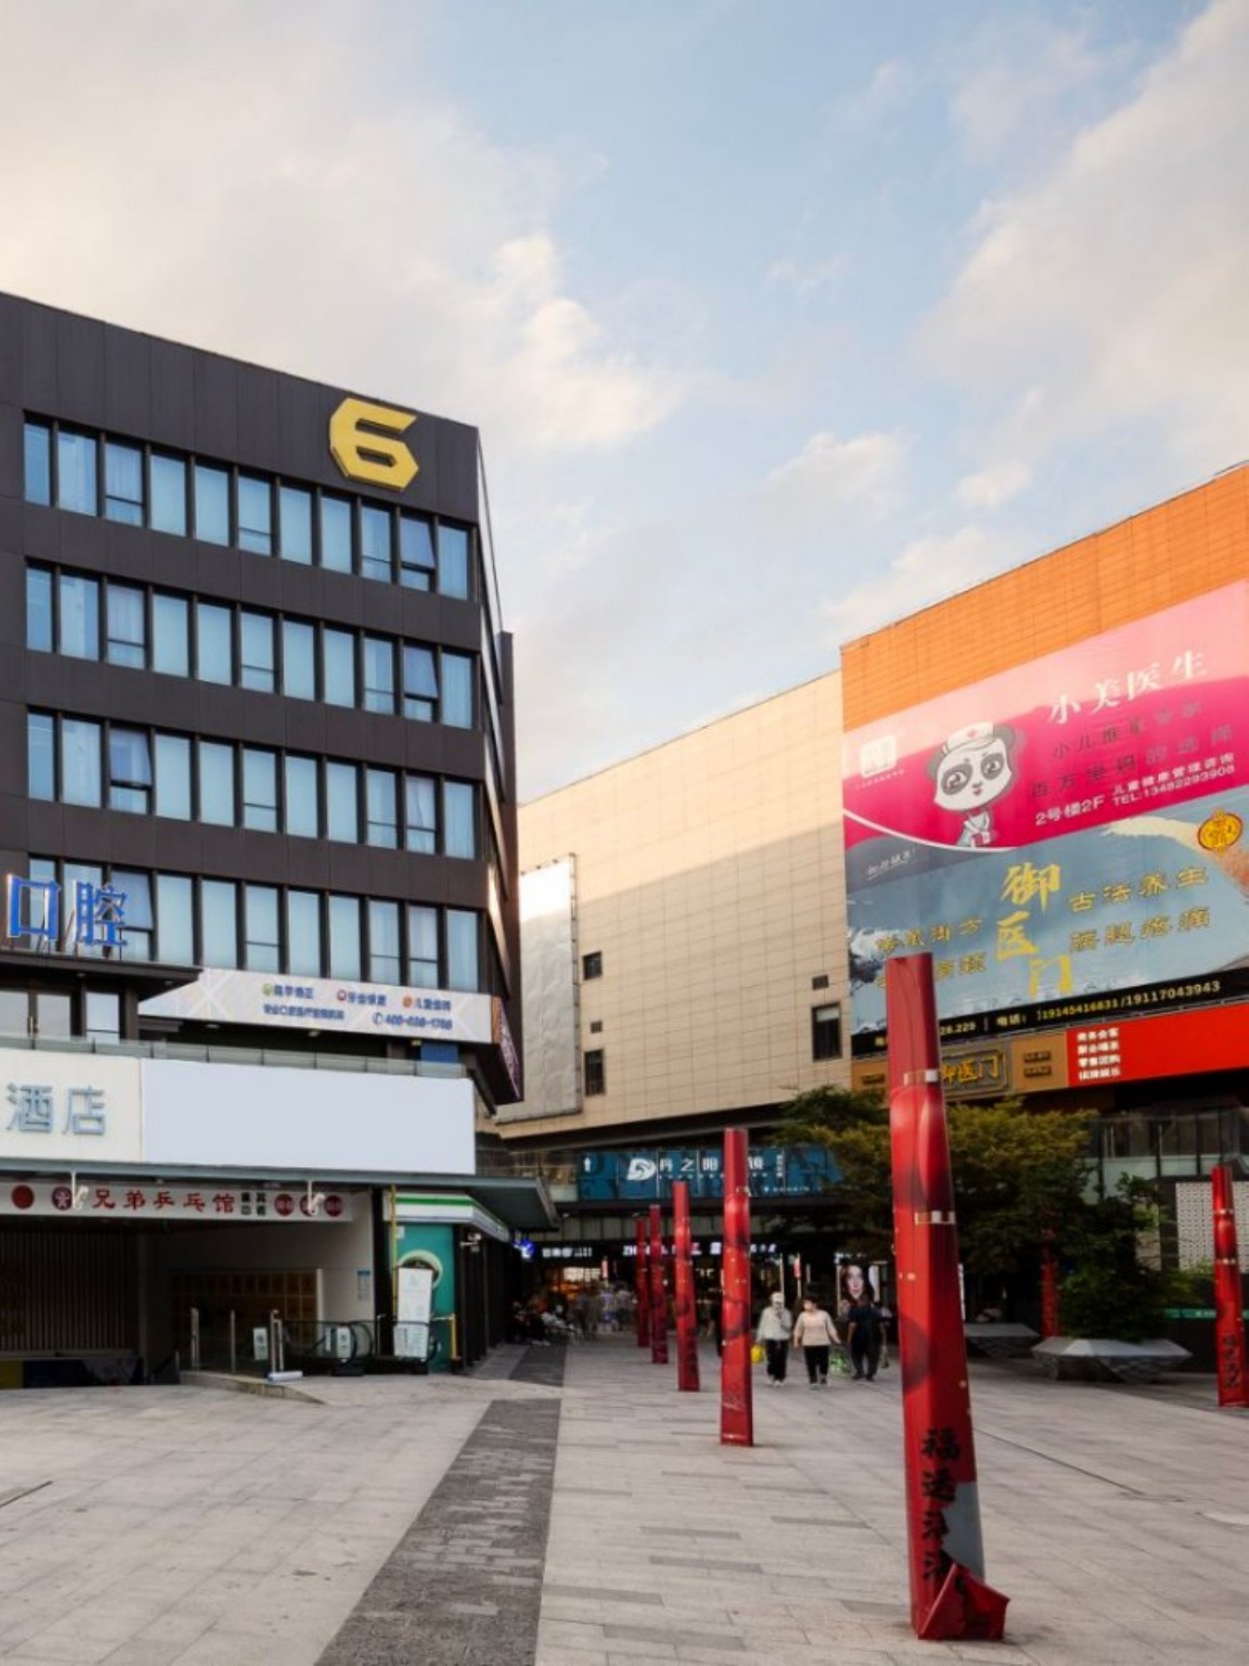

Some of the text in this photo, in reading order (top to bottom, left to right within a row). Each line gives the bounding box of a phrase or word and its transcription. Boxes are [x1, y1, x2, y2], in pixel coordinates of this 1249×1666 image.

[329, 397, 420, 491] 6
[1049, 649, 1208, 725] 小美医生
[1035, 795, 1105, 826] 2号楼2F
[92, 1187, 236, 1214] 兄弟乒乓馆
